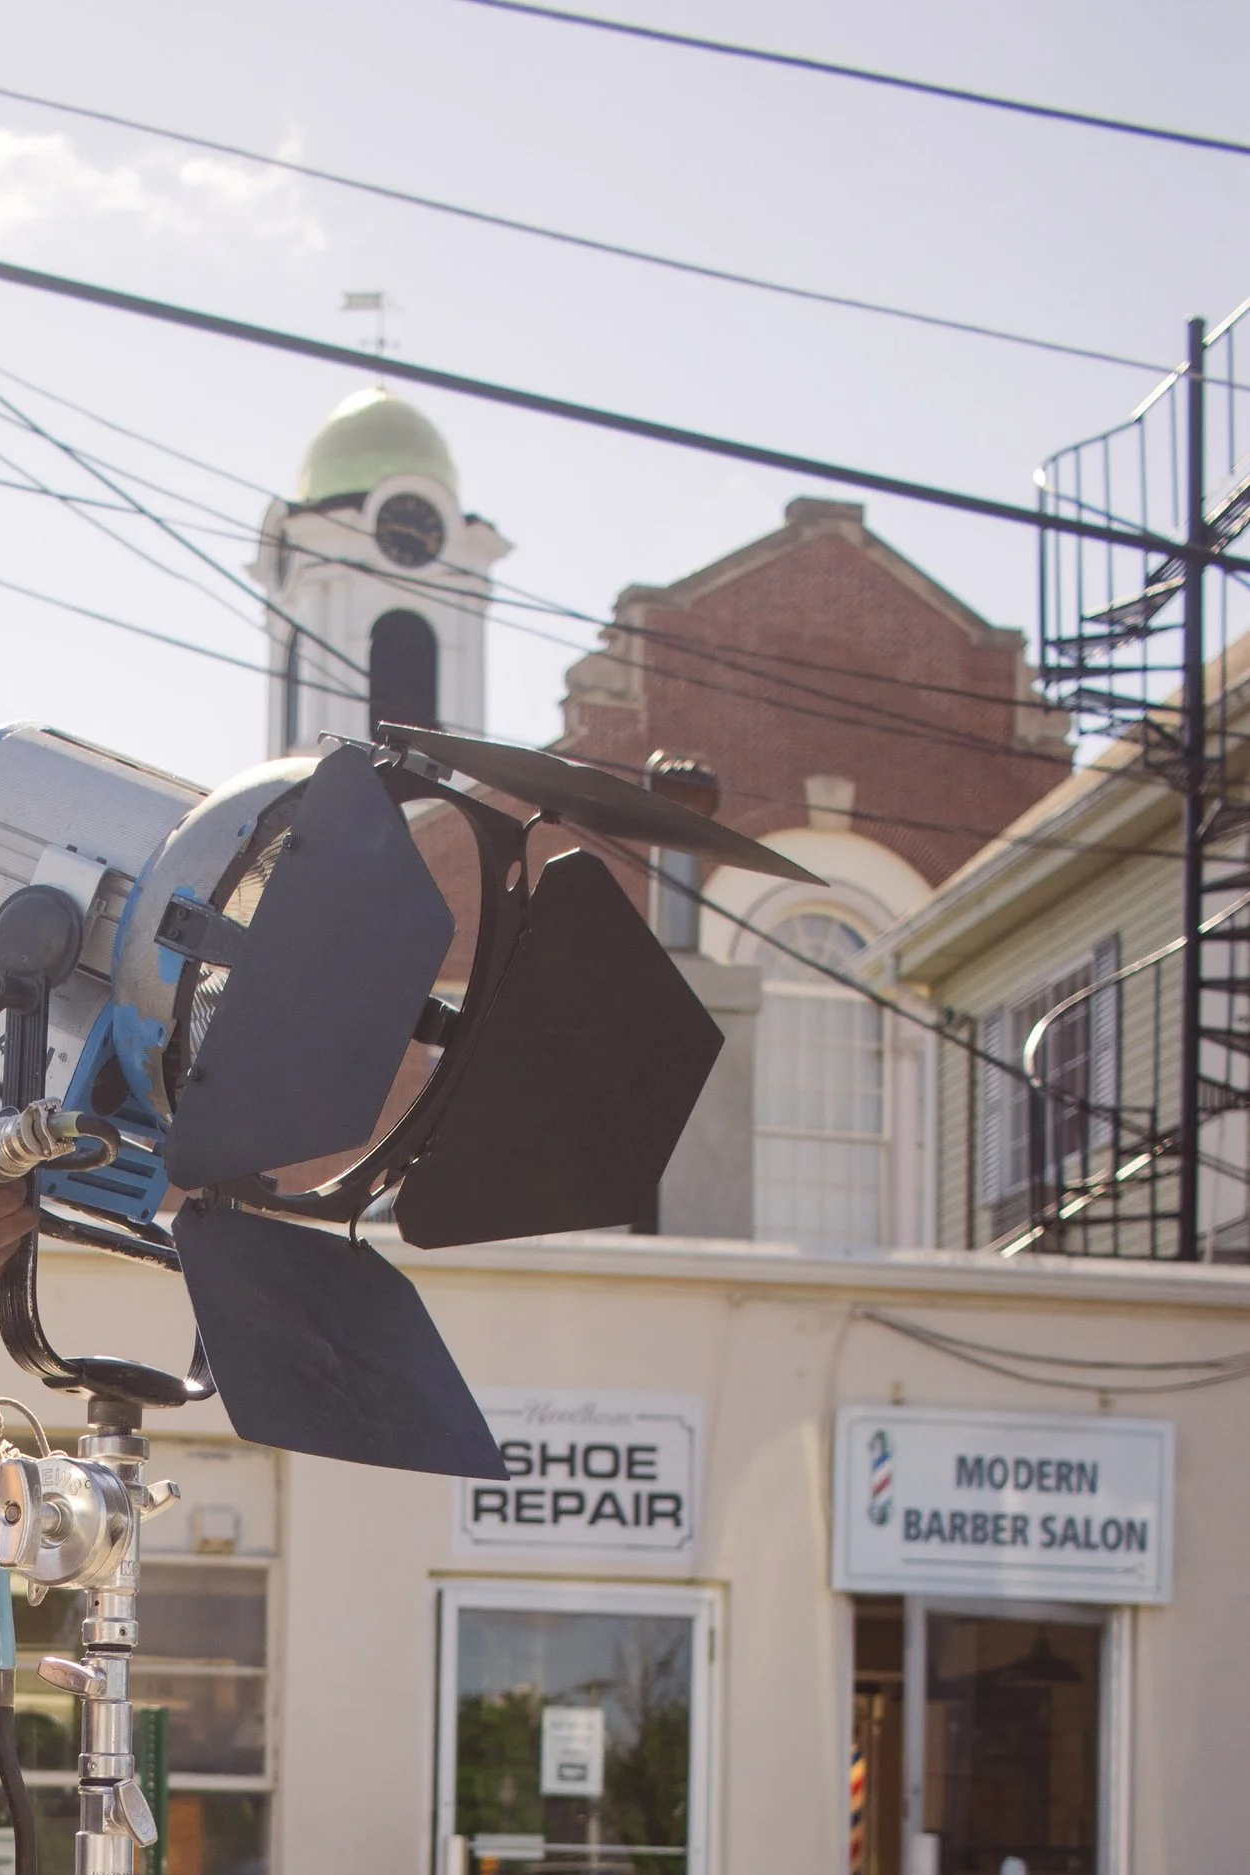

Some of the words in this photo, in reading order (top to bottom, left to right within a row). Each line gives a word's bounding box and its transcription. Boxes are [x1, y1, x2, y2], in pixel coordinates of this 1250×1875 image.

[500, 1440, 658, 1481] SHOE
[955, 1454, 1099, 1494] MODERN
[473, 1488, 682, 1527] REPAIR
[903, 1508, 1030, 1547] BARBER
[1040, 1515, 1148, 1553] SALON
